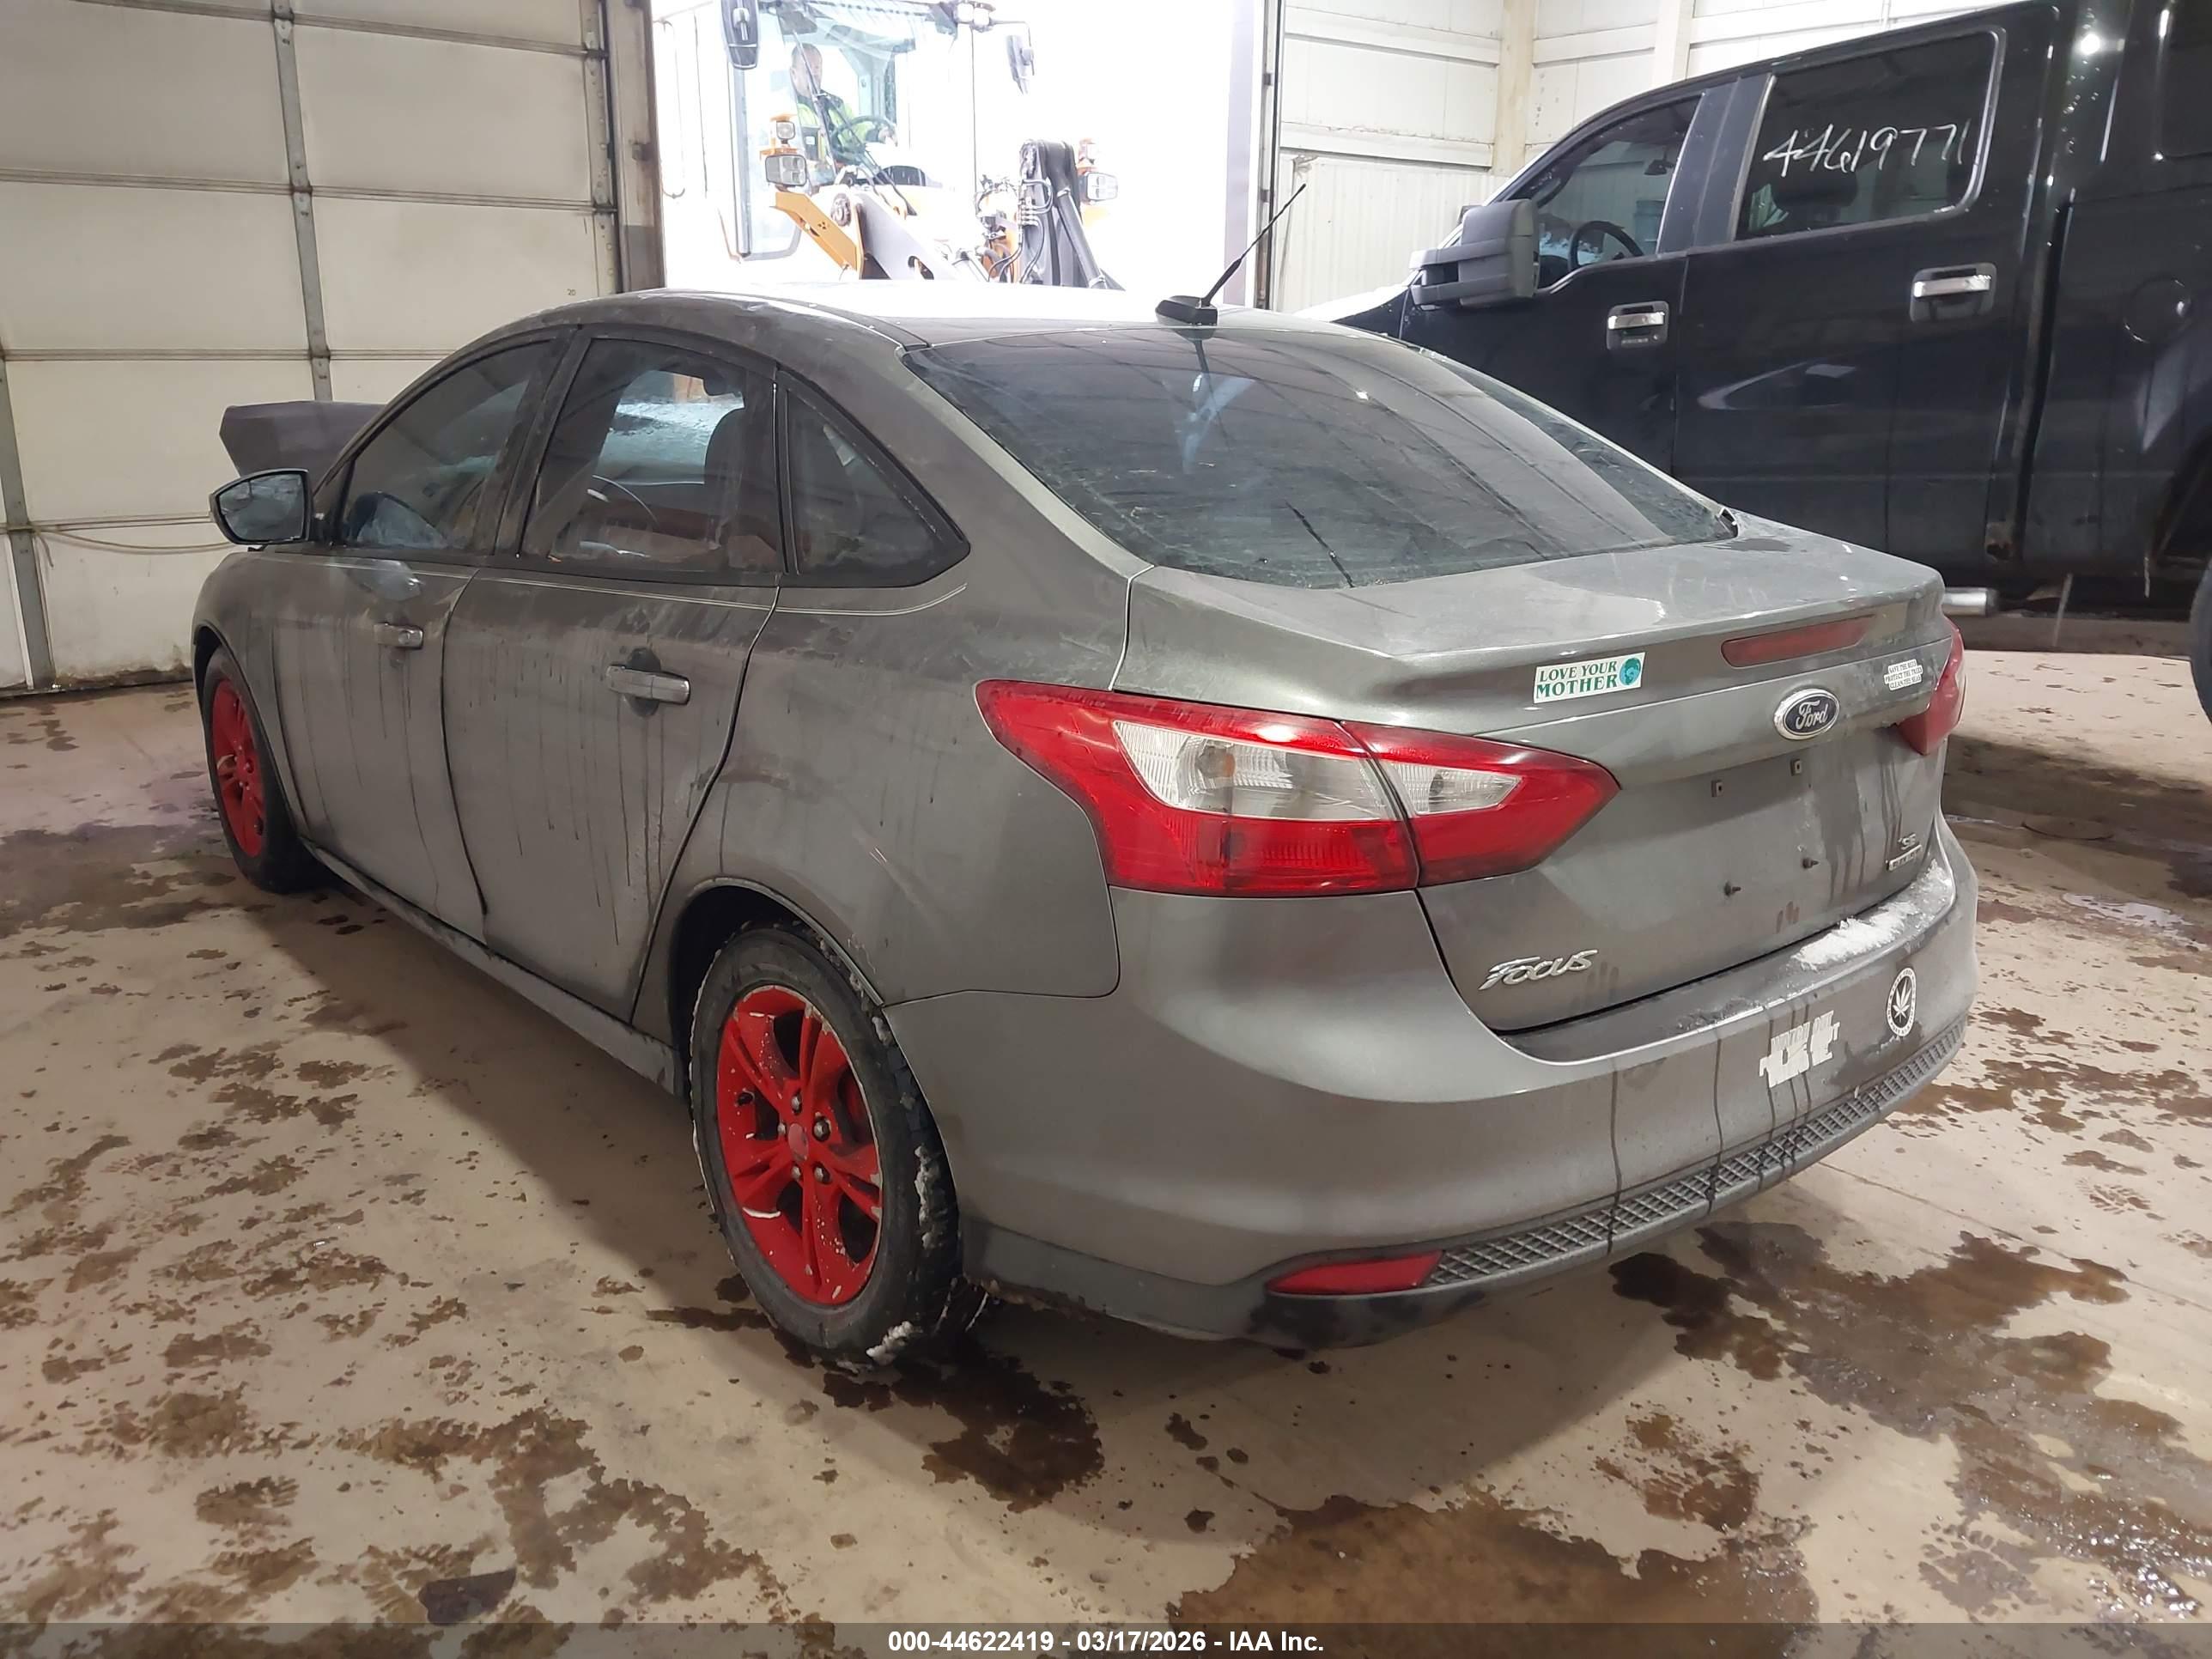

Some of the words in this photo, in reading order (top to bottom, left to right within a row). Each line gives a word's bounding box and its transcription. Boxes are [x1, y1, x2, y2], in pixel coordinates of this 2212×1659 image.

[1763, 118, 1971, 177] 44619771
[1540, 665, 1577, 683] LOVE
[1581, 660, 1618, 677] YOUR
[1535, 673, 1618, 699] MOTHER
[1795, 700, 1828, 730] Ford
